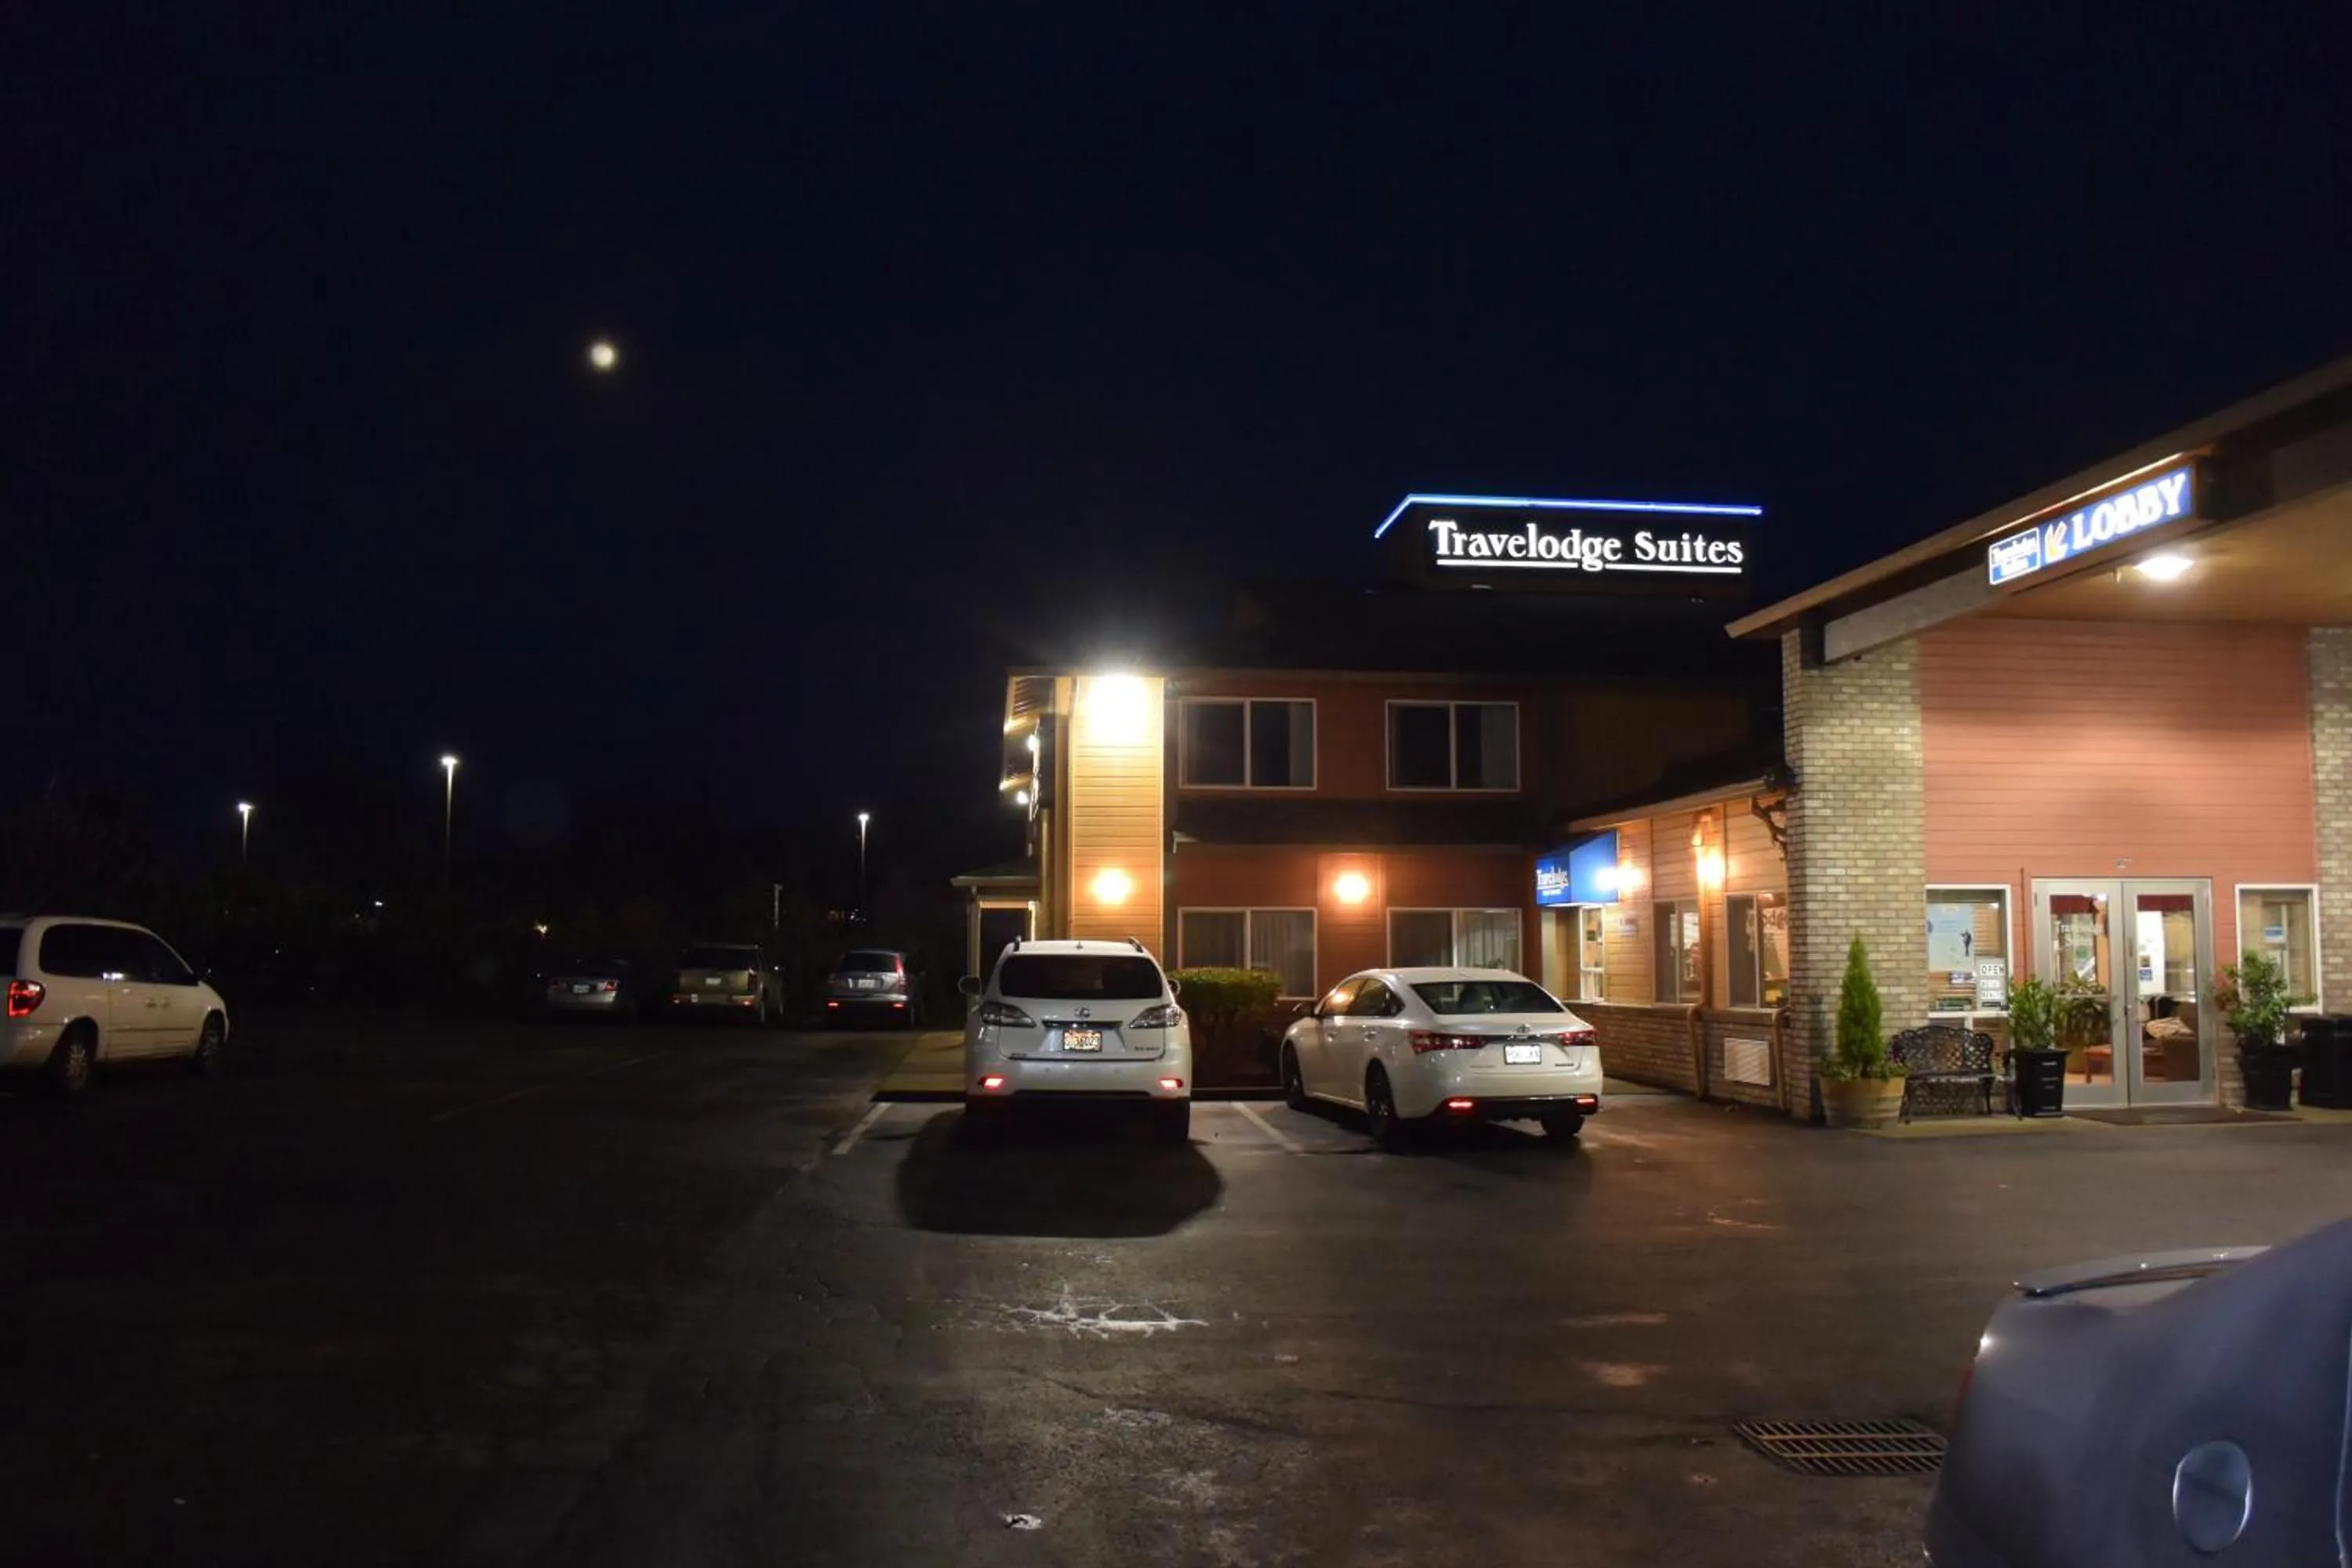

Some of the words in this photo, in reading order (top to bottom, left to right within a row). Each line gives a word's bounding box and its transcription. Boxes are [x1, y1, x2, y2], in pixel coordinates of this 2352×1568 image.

[2071, 472, 2187, 550] LOBBY
[1428, 519, 1622, 572] Travelodge
[1635, 531, 1744, 564] Suites
